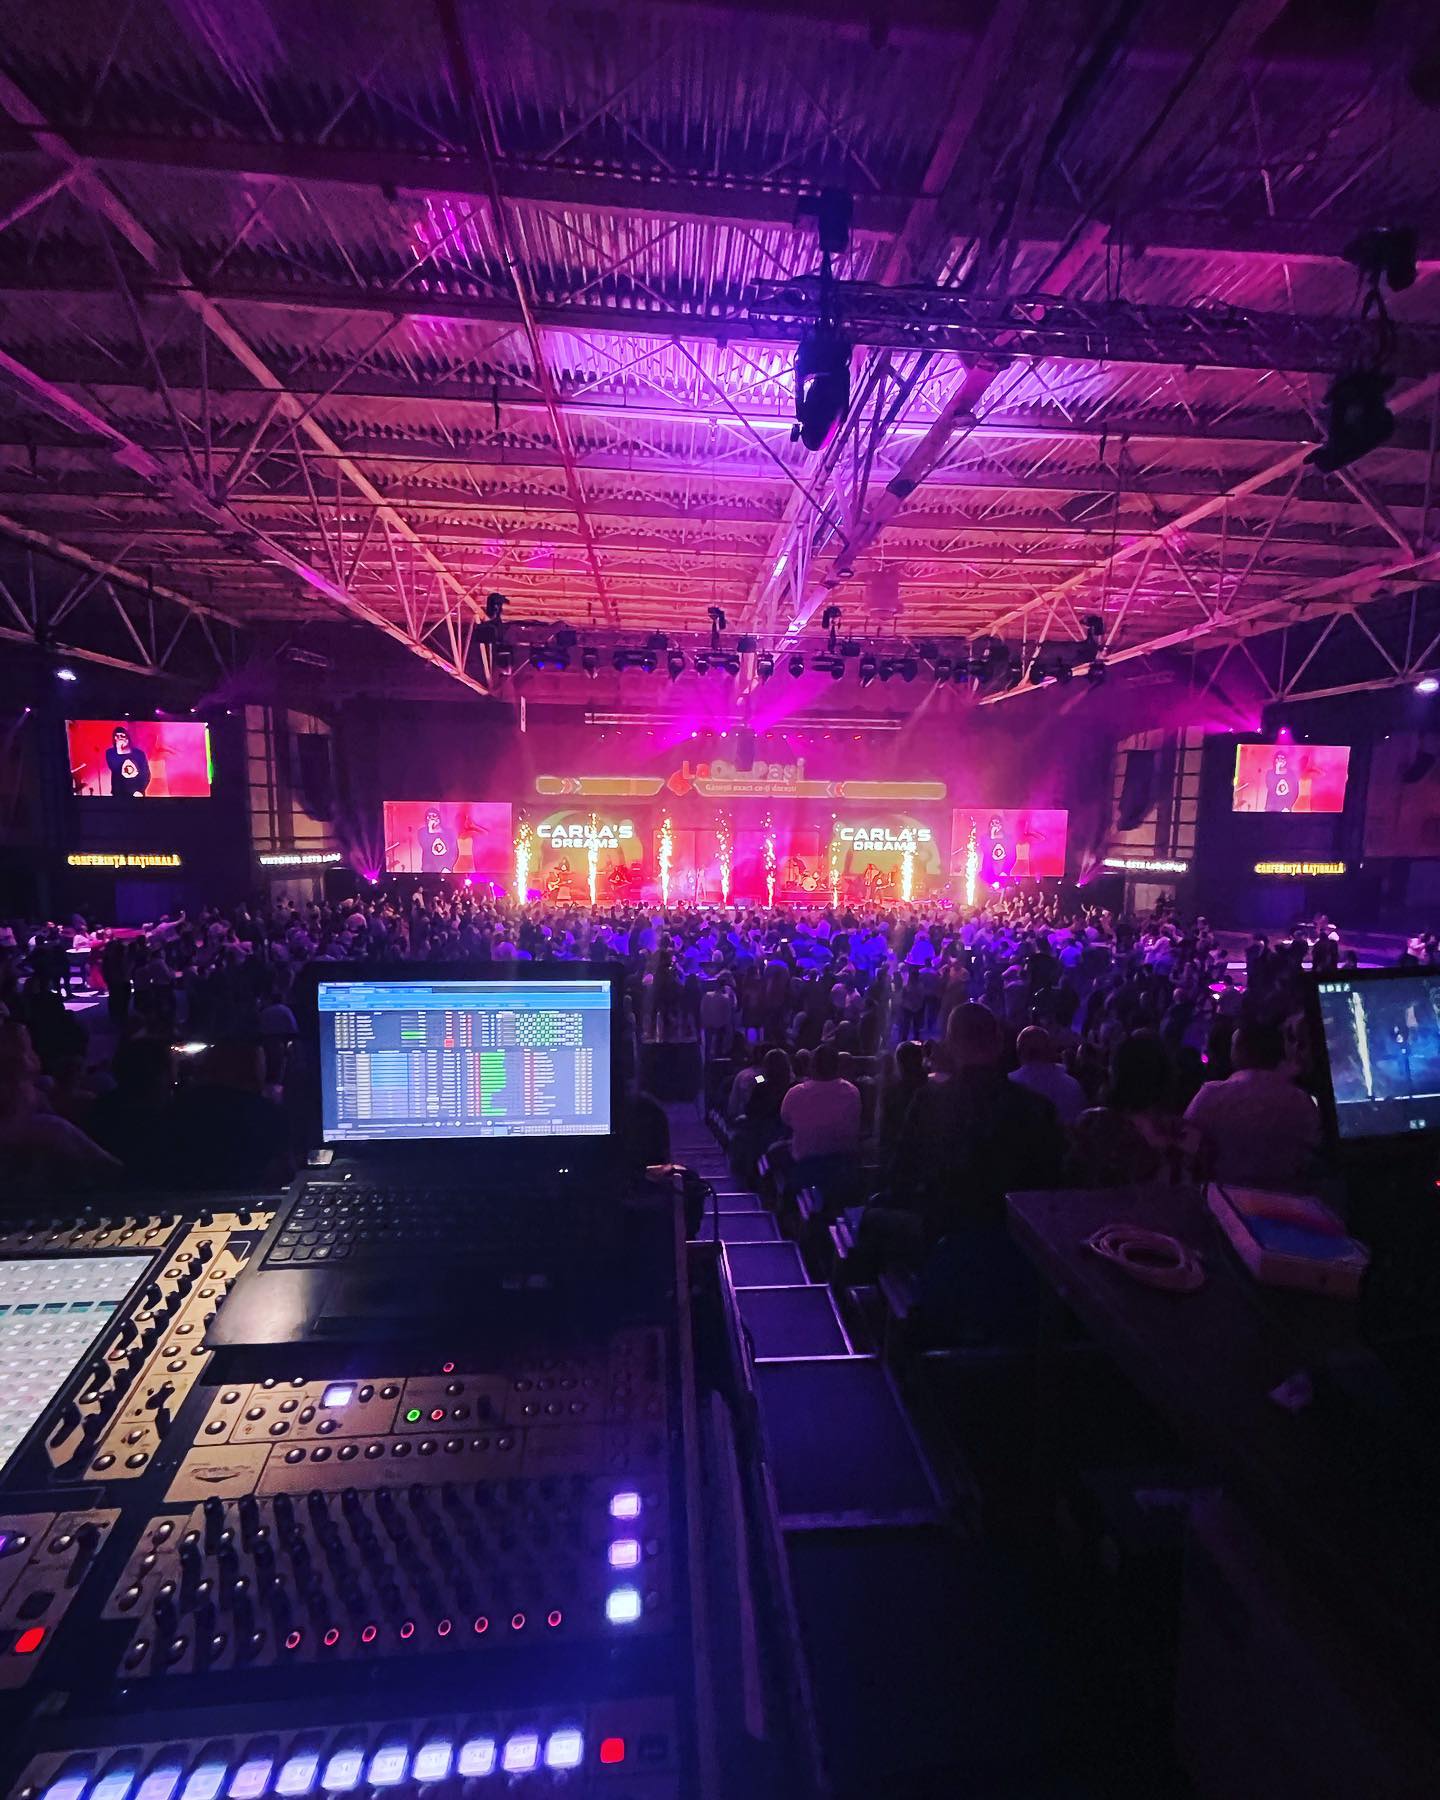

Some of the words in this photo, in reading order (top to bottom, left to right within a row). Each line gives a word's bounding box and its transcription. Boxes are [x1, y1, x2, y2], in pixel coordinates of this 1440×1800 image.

[536, 824, 633, 839] CARLA'S
[840, 827, 931, 842] CARLA'S
[551, 838, 619, 848] DREAMS
[853, 841, 917, 851] DREAMS
